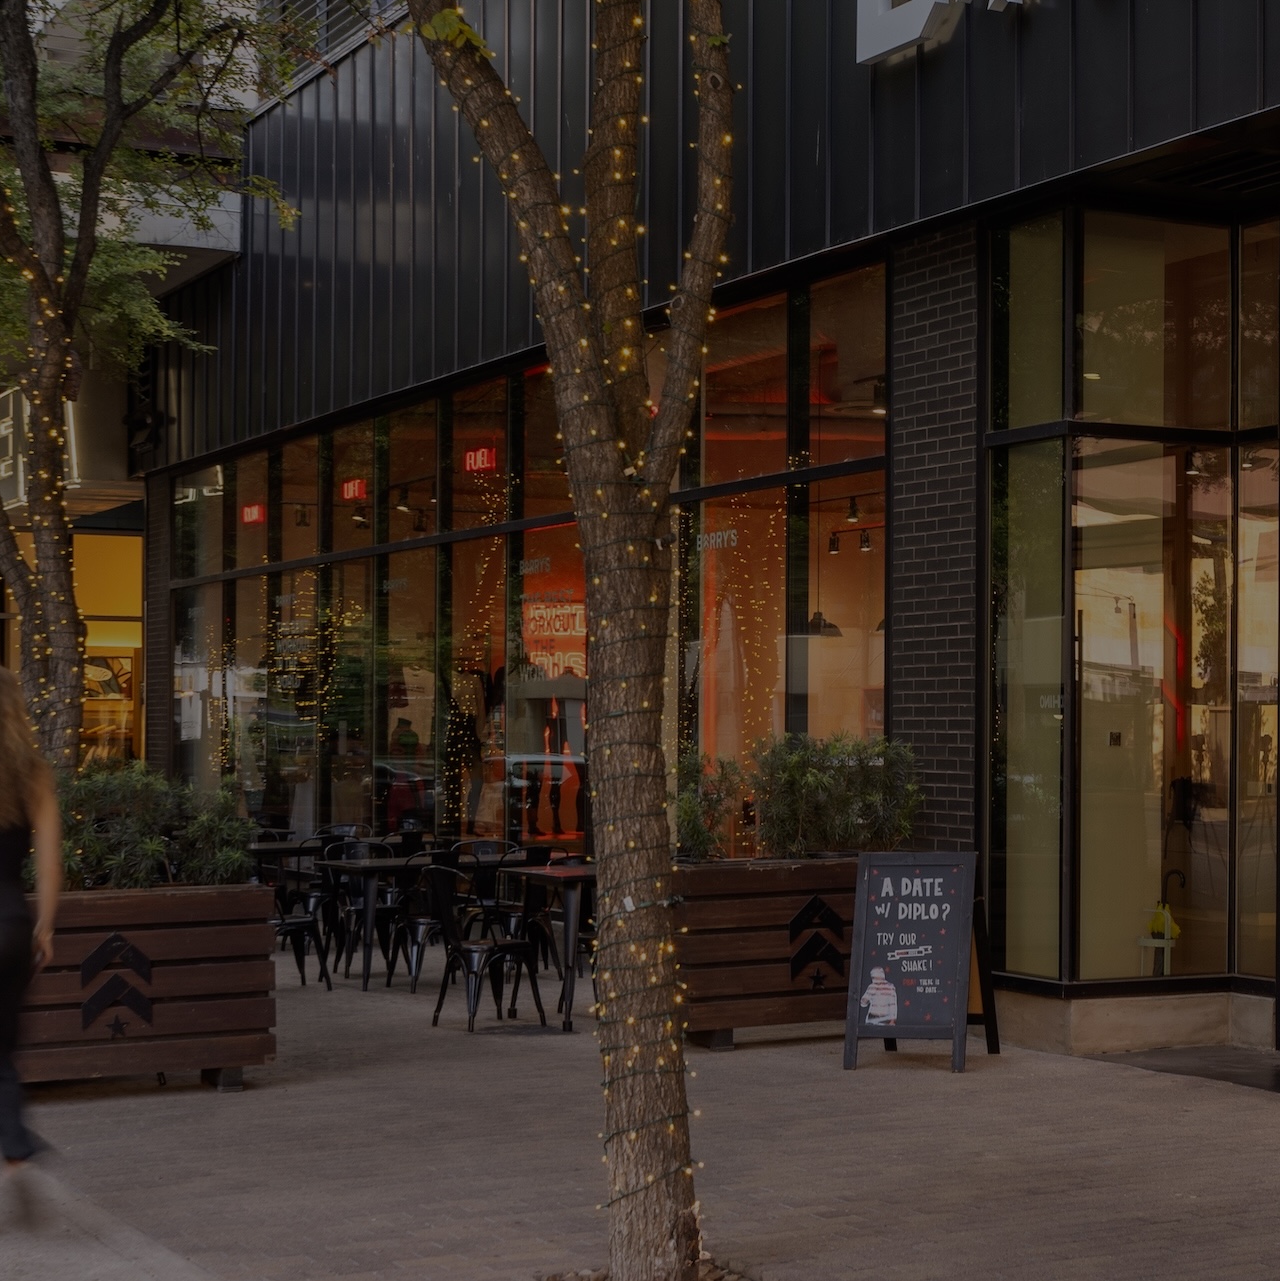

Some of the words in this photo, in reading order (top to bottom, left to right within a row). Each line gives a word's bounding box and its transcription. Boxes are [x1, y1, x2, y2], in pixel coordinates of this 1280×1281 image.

[696, 529, 738, 552] BARRY'S
[881, 877, 894, 897] A
[901, 877, 944, 897] DATE
[877, 932, 895, 946] TRY
[899, 932, 917, 946] OUR
